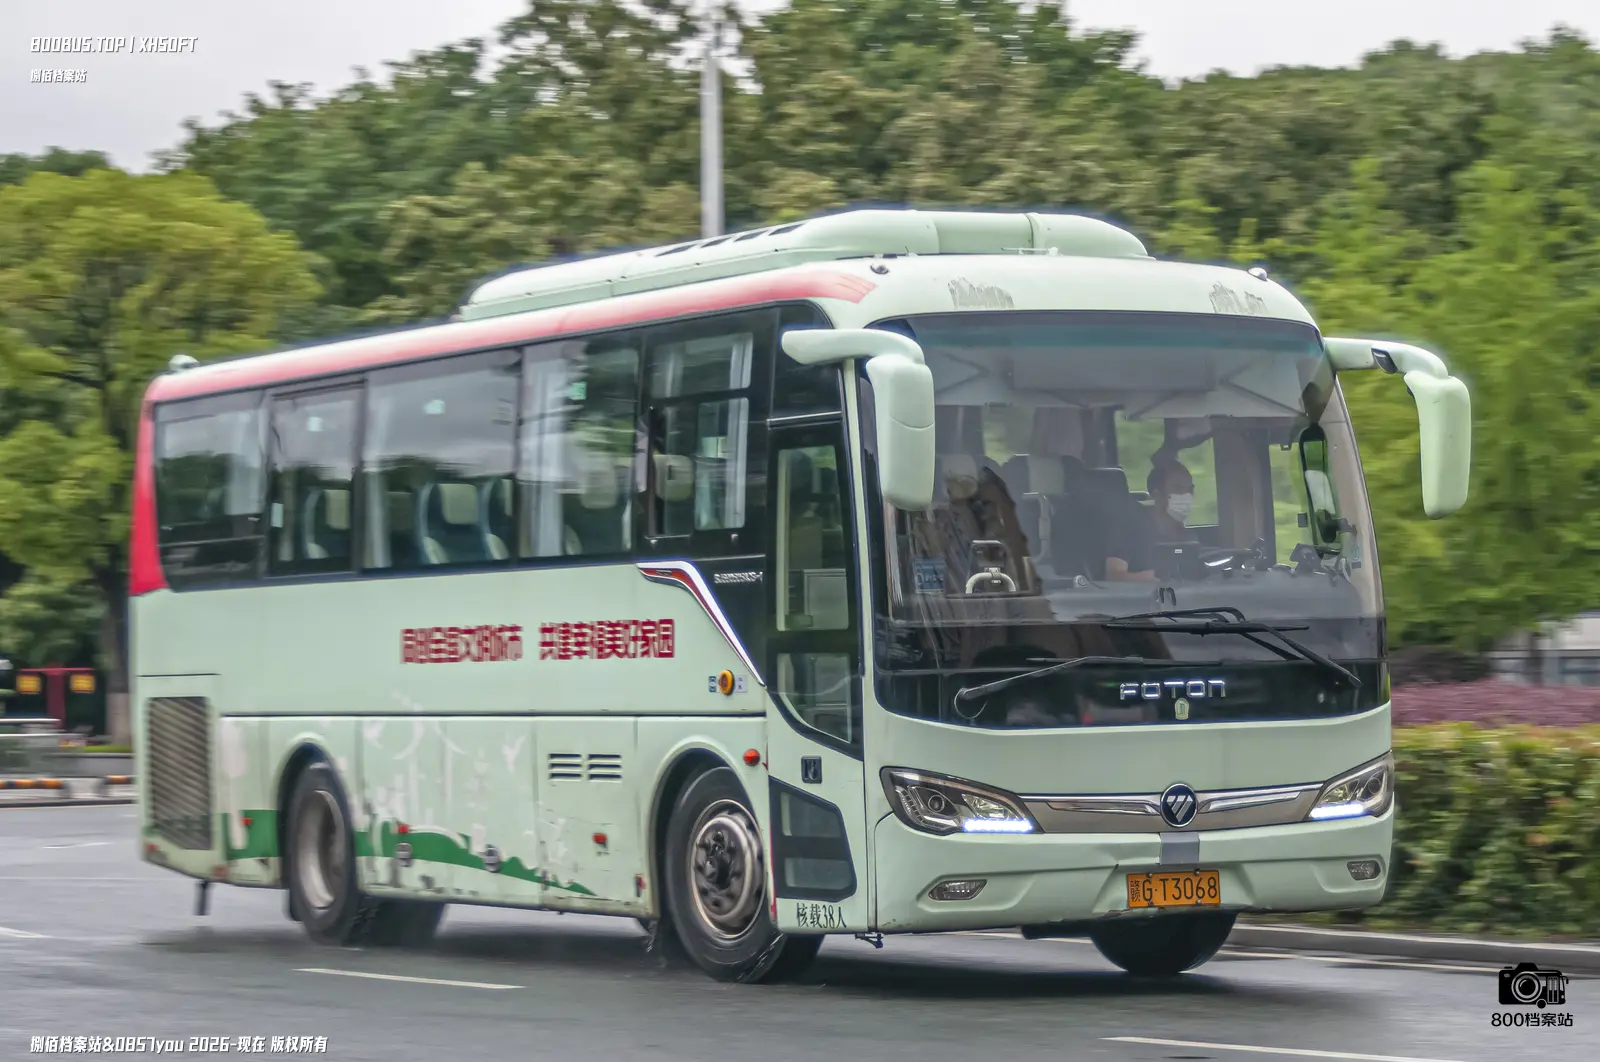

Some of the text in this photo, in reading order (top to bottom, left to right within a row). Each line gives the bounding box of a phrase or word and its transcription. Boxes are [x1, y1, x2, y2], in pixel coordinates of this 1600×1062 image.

[539, 618, 675, 660] 共建幸福美好家园
[1119, 679, 1226, 700] FOTON
[795, 902, 847, 930] 核载38人
